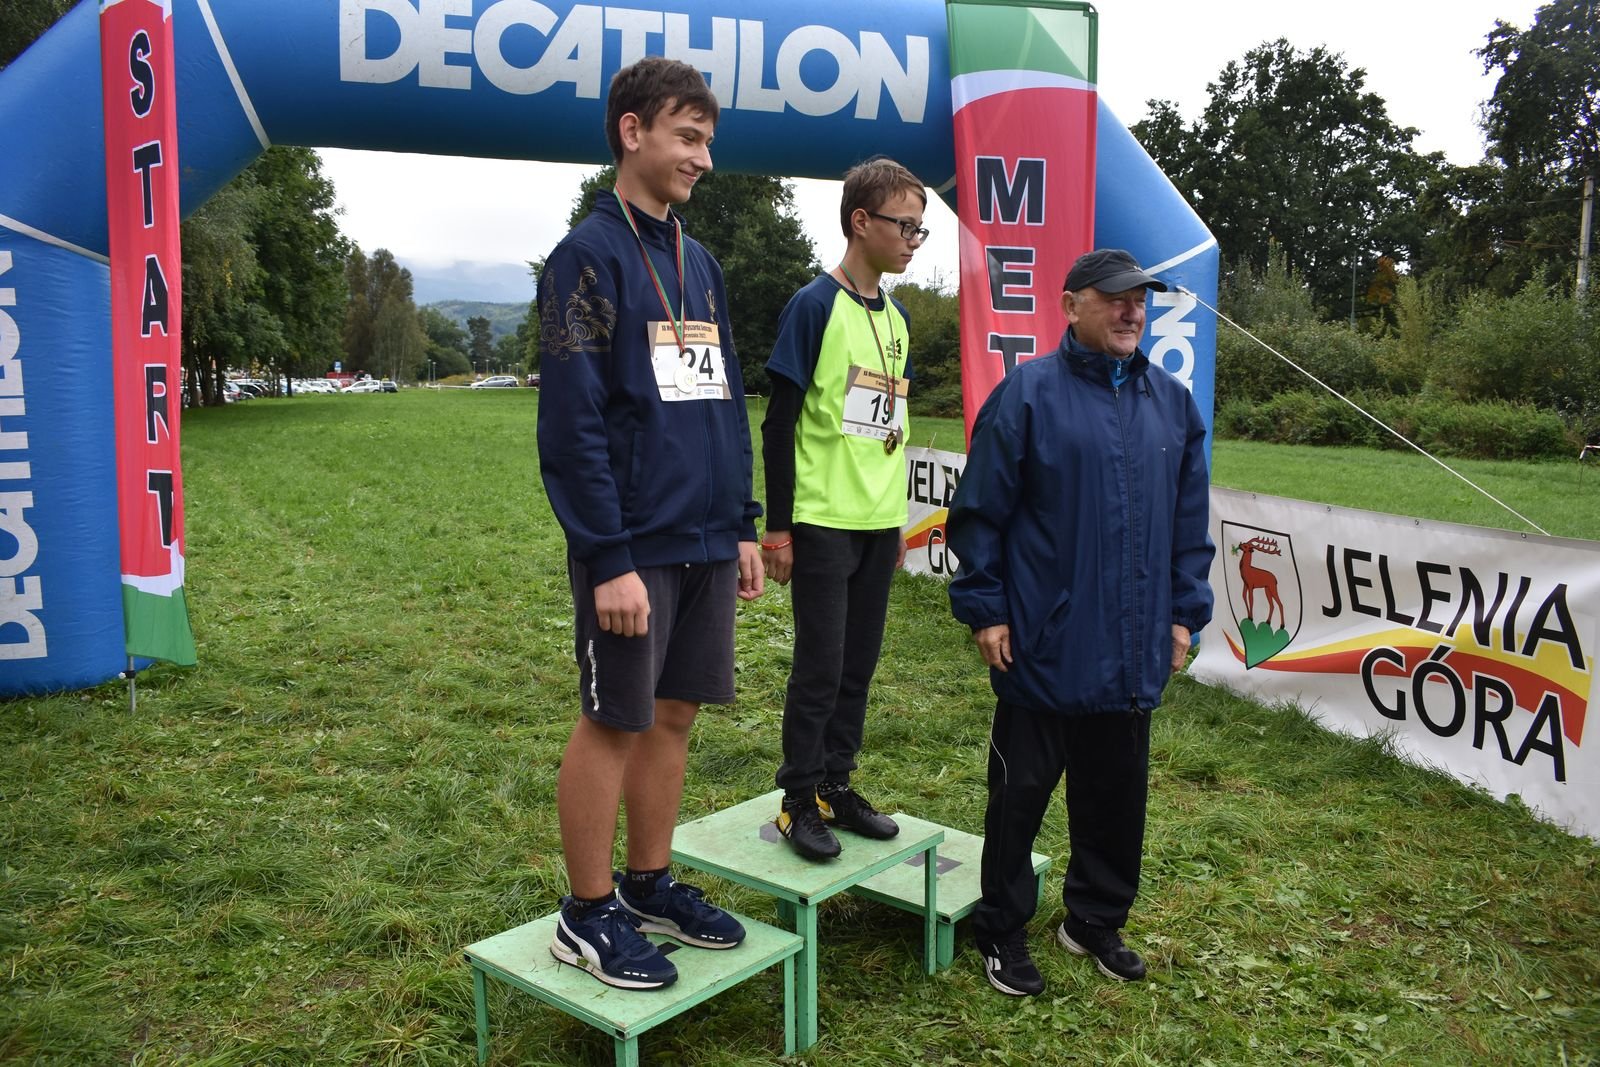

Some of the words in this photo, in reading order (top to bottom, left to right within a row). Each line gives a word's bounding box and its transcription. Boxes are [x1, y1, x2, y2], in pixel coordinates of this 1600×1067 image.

[339, 0, 930, 123] DECATHLON
[129, 29, 173, 548] START
[907, 459, 961, 508] JELE
[1321, 544, 1586, 671] JELENIA
[1360, 645, 1567, 785] GÓRA
